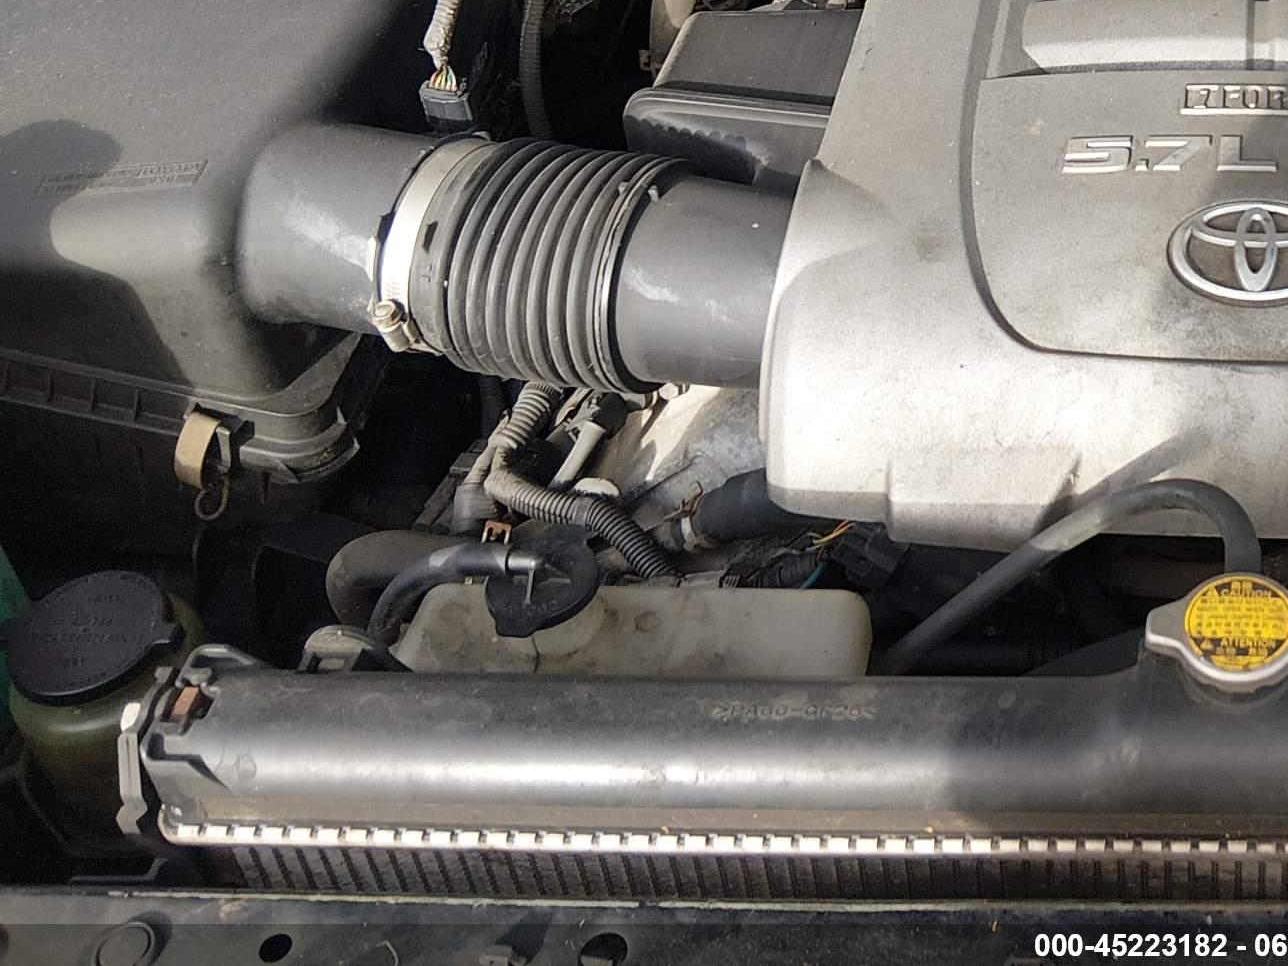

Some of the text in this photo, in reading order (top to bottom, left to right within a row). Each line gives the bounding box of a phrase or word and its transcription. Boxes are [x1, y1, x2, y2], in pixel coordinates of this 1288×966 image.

[1062, 135, 1277, 173] 5.7L
[1220, 588, 1272, 598] CAUTION
[1220, 637, 1276, 649] ATTENTION
